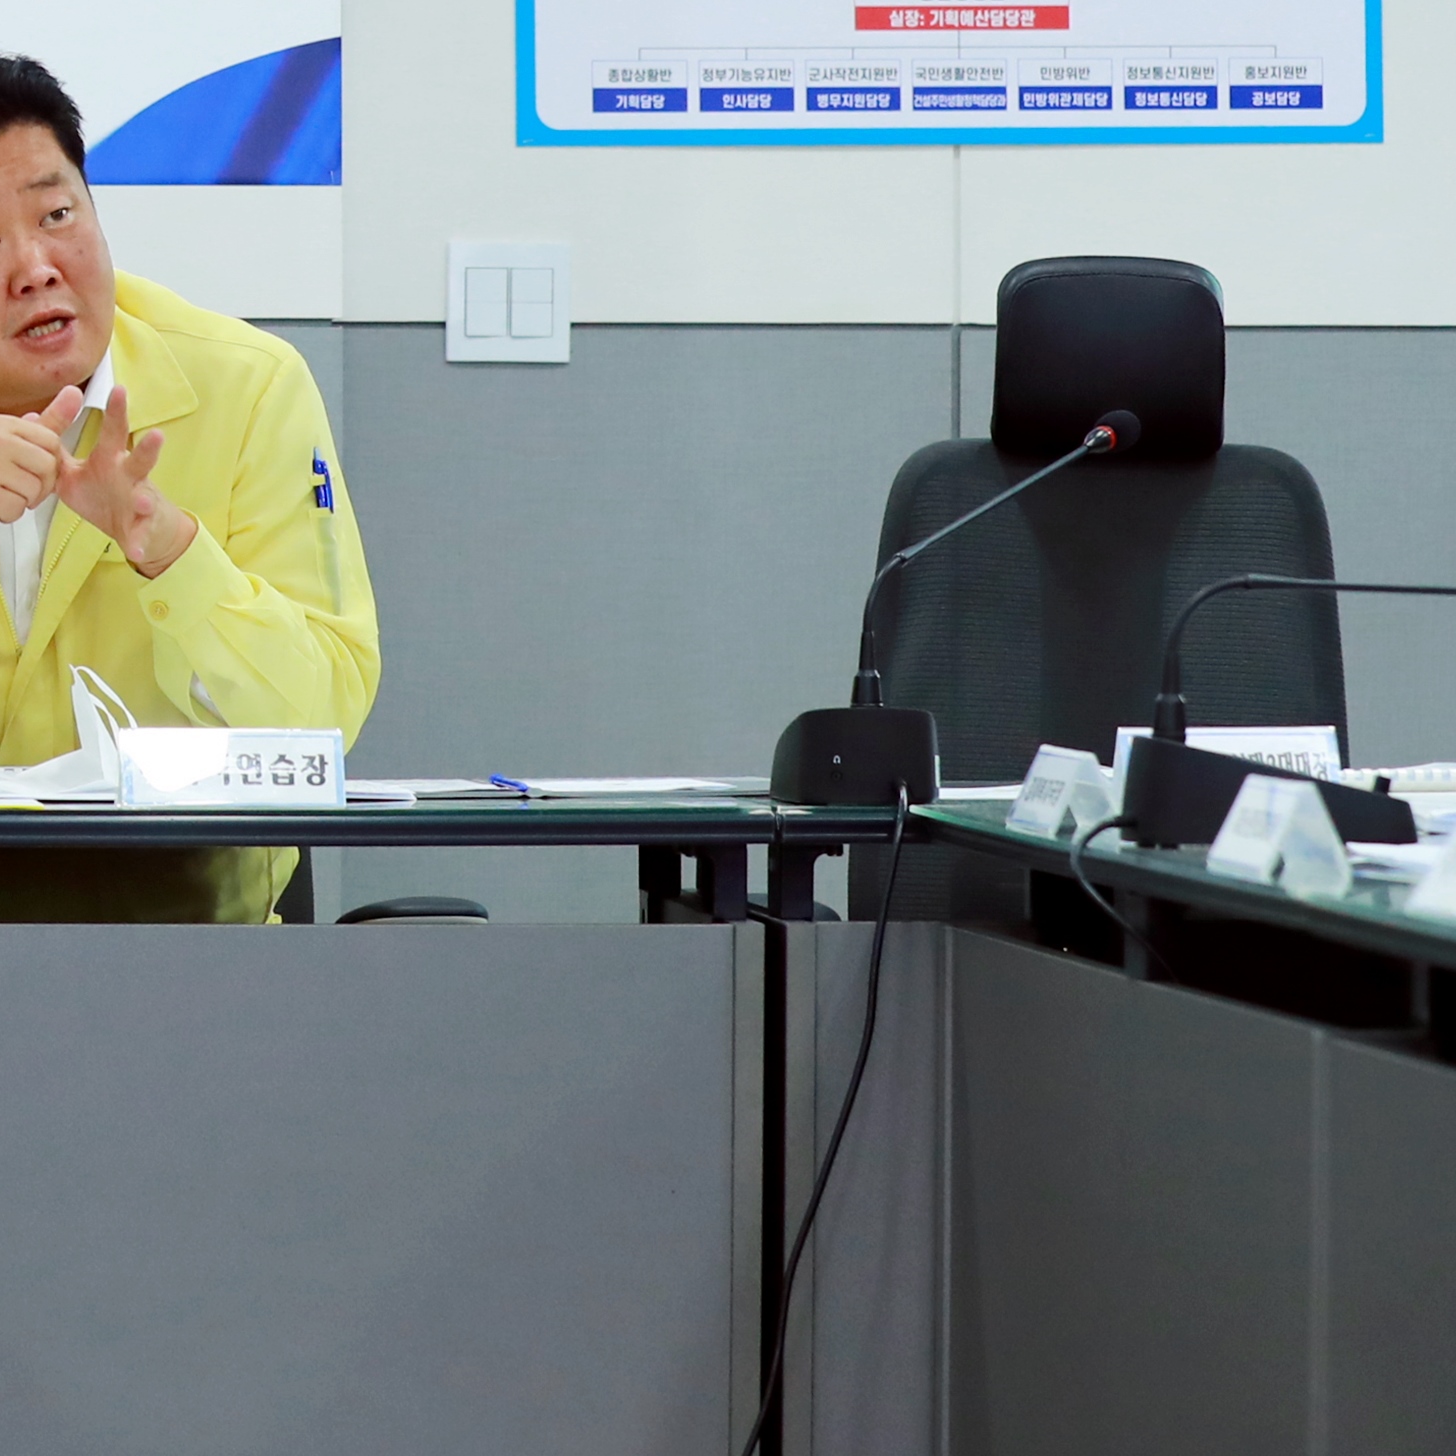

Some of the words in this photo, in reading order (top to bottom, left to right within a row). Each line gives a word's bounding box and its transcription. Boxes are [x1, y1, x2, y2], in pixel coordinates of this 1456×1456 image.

[930, 10, 1035, 26] 기획예산담당관
[609, 69, 671, 82] 종합상황반
[703, 68, 791, 82] 정부기능유지반
[810, 68, 897, 81] 군사작전지원반
[1041, 67, 1090, 80] 민방위반
[1128, 67, 1214, 79] 정보통신지원반
[1246, 66, 1307, 79] 홍보지원반
[617, 95, 664, 108] 기획담당
[723, 94, 771, 108] 인사담당
[1136, 92, 1207, 106] 정보통신담당
[1253, 92, 1300, 106] 공보담당
